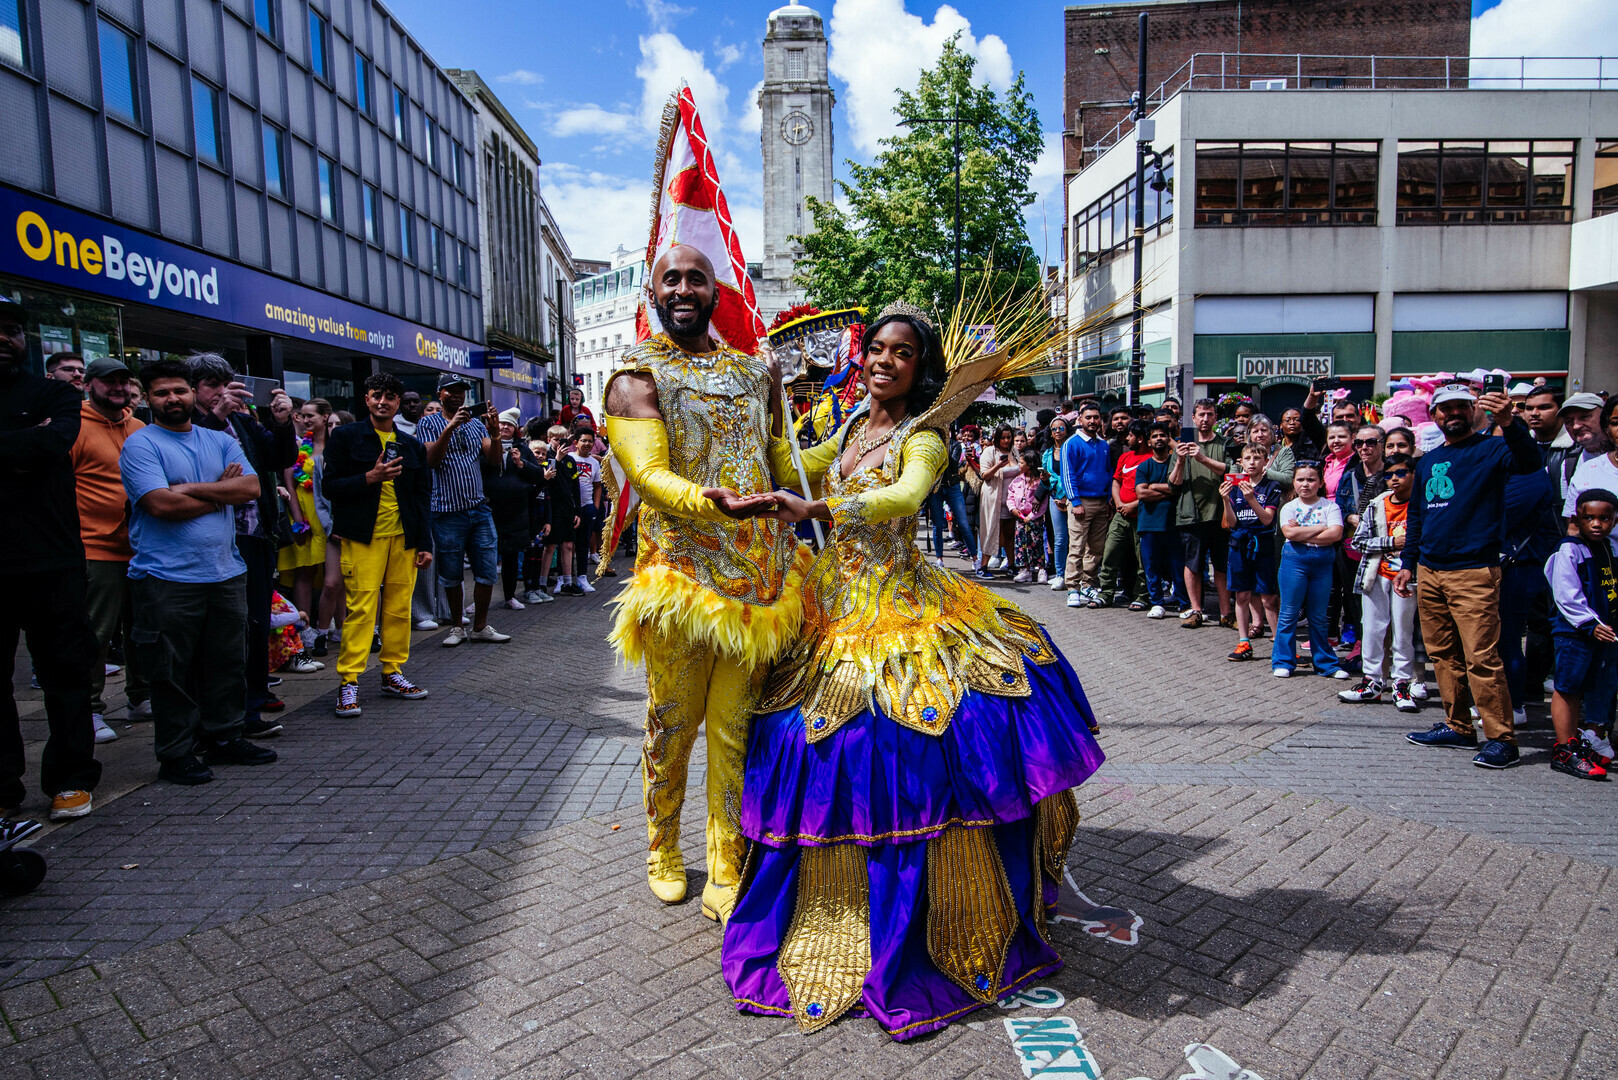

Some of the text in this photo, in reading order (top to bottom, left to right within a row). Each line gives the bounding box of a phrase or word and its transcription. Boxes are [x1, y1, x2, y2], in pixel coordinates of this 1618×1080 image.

[16, 210, 219, 305] OneBeyond
[265, 303, 395, 350] amazing value from only £1
[416, 332, 470, 369] OneBeyond
[1245, 359, 1329, 375] DON MILLERS
[1107, 373, 1127, 388] MILLERS
[1260, 379, 1272, 387] HOT
